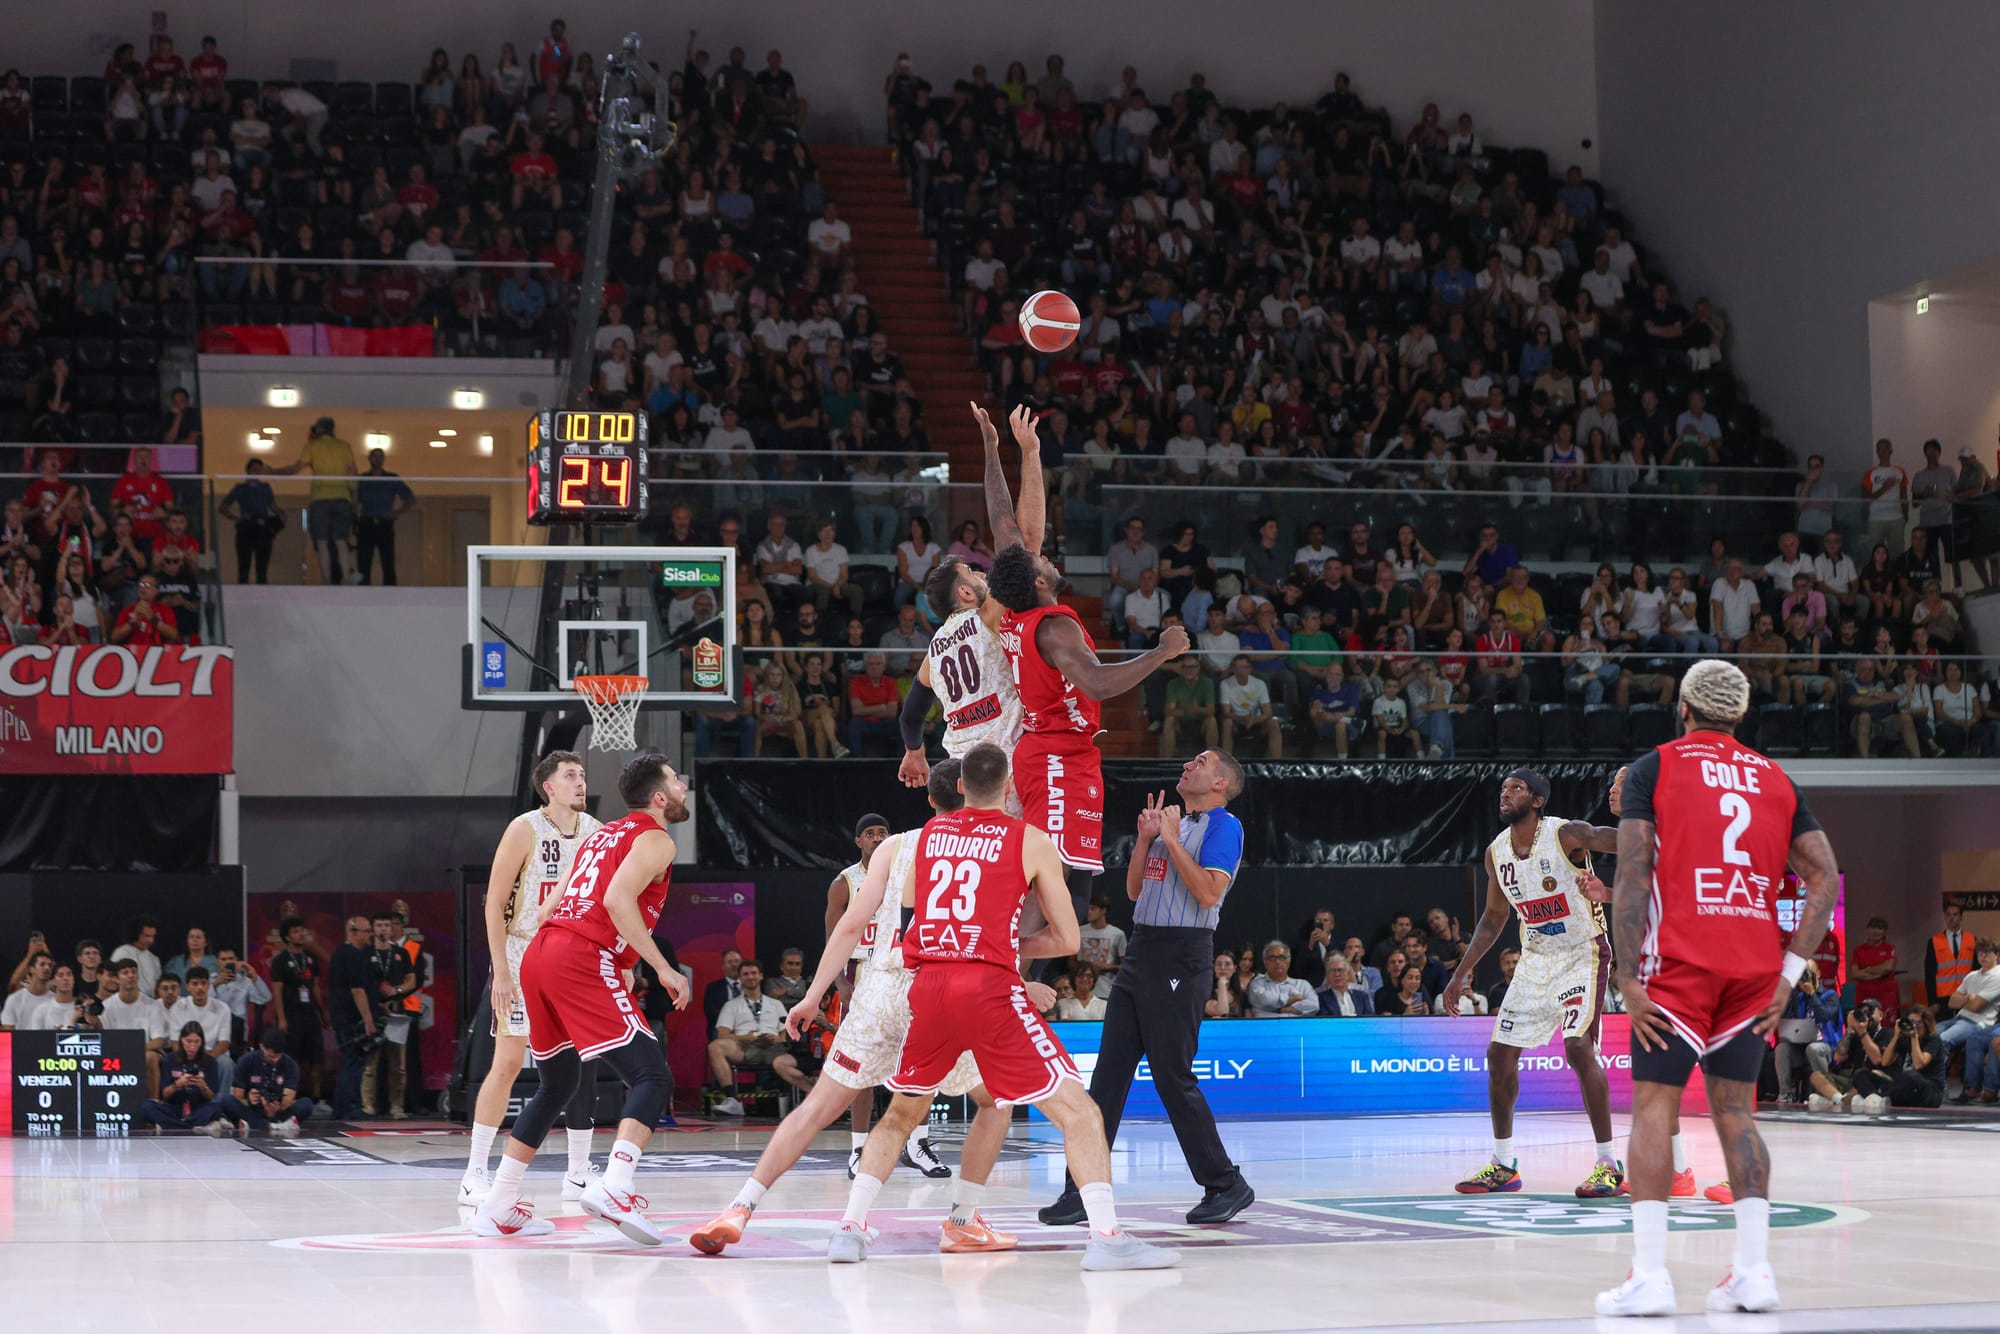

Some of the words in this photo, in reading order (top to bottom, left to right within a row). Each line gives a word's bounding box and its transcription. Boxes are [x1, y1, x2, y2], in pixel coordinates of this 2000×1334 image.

[564, 446, 590, 455] LOTUS
[599, 446, 625, 455] LOTUS
[560, 458, 629, 508] 24
[0, 644, 233, 697] CIOLT
[697, 657, 718, 666] LBA
[485, 671, 505, 679] FIP
[940, 644, 981, 703] 00
[55, 725, 165, 755] MILANO
[1733, 750, 1772, 770] AON
[1701, 760, 1761, 794] COLE
[971, 823, 1008, 837] AON
[1719, 792, 1752, 867] 2
[542, 840, 560, 863] 33
[925, 832, 1003, 863] GUDURIĆ
[564, 849, 607, 898] 25
[1500, 862, 1519, 886] 22
[925, 859, 982, 922] 23
[1694, 867, 1770, 908] EA7
[919, 924, 982, 954] EA7
[56, 1045, 101, 1055] LOTUS
[38, 1058, 77, 1071] 10:00
[81, 1060, 95, 1070] Q1
[102, 1058, 120, 1071] 24
[1134, 1059, 1253, 1080] GELY
[1351, 1060, 1367, 1073] IL
[1371, 1058, 1444, 1073] MONDO
[1447, 1054, 1461, 1072] È
[1464, 1057, 1481, 1071] IL
[19, 1075, 72, 1086] VENEZIA
[88, 1075, 138, 1086] MILANO
[39, 1091, 52, 1108] 0
[107, 1091, 120, 1108] 0
[27, 1113, 39, 1121] TO
[95, 1113, 107, 1121] TO
[28, 1123, 51, 1131] FALLI
[96, 1123, 118, 1131] FALLI
